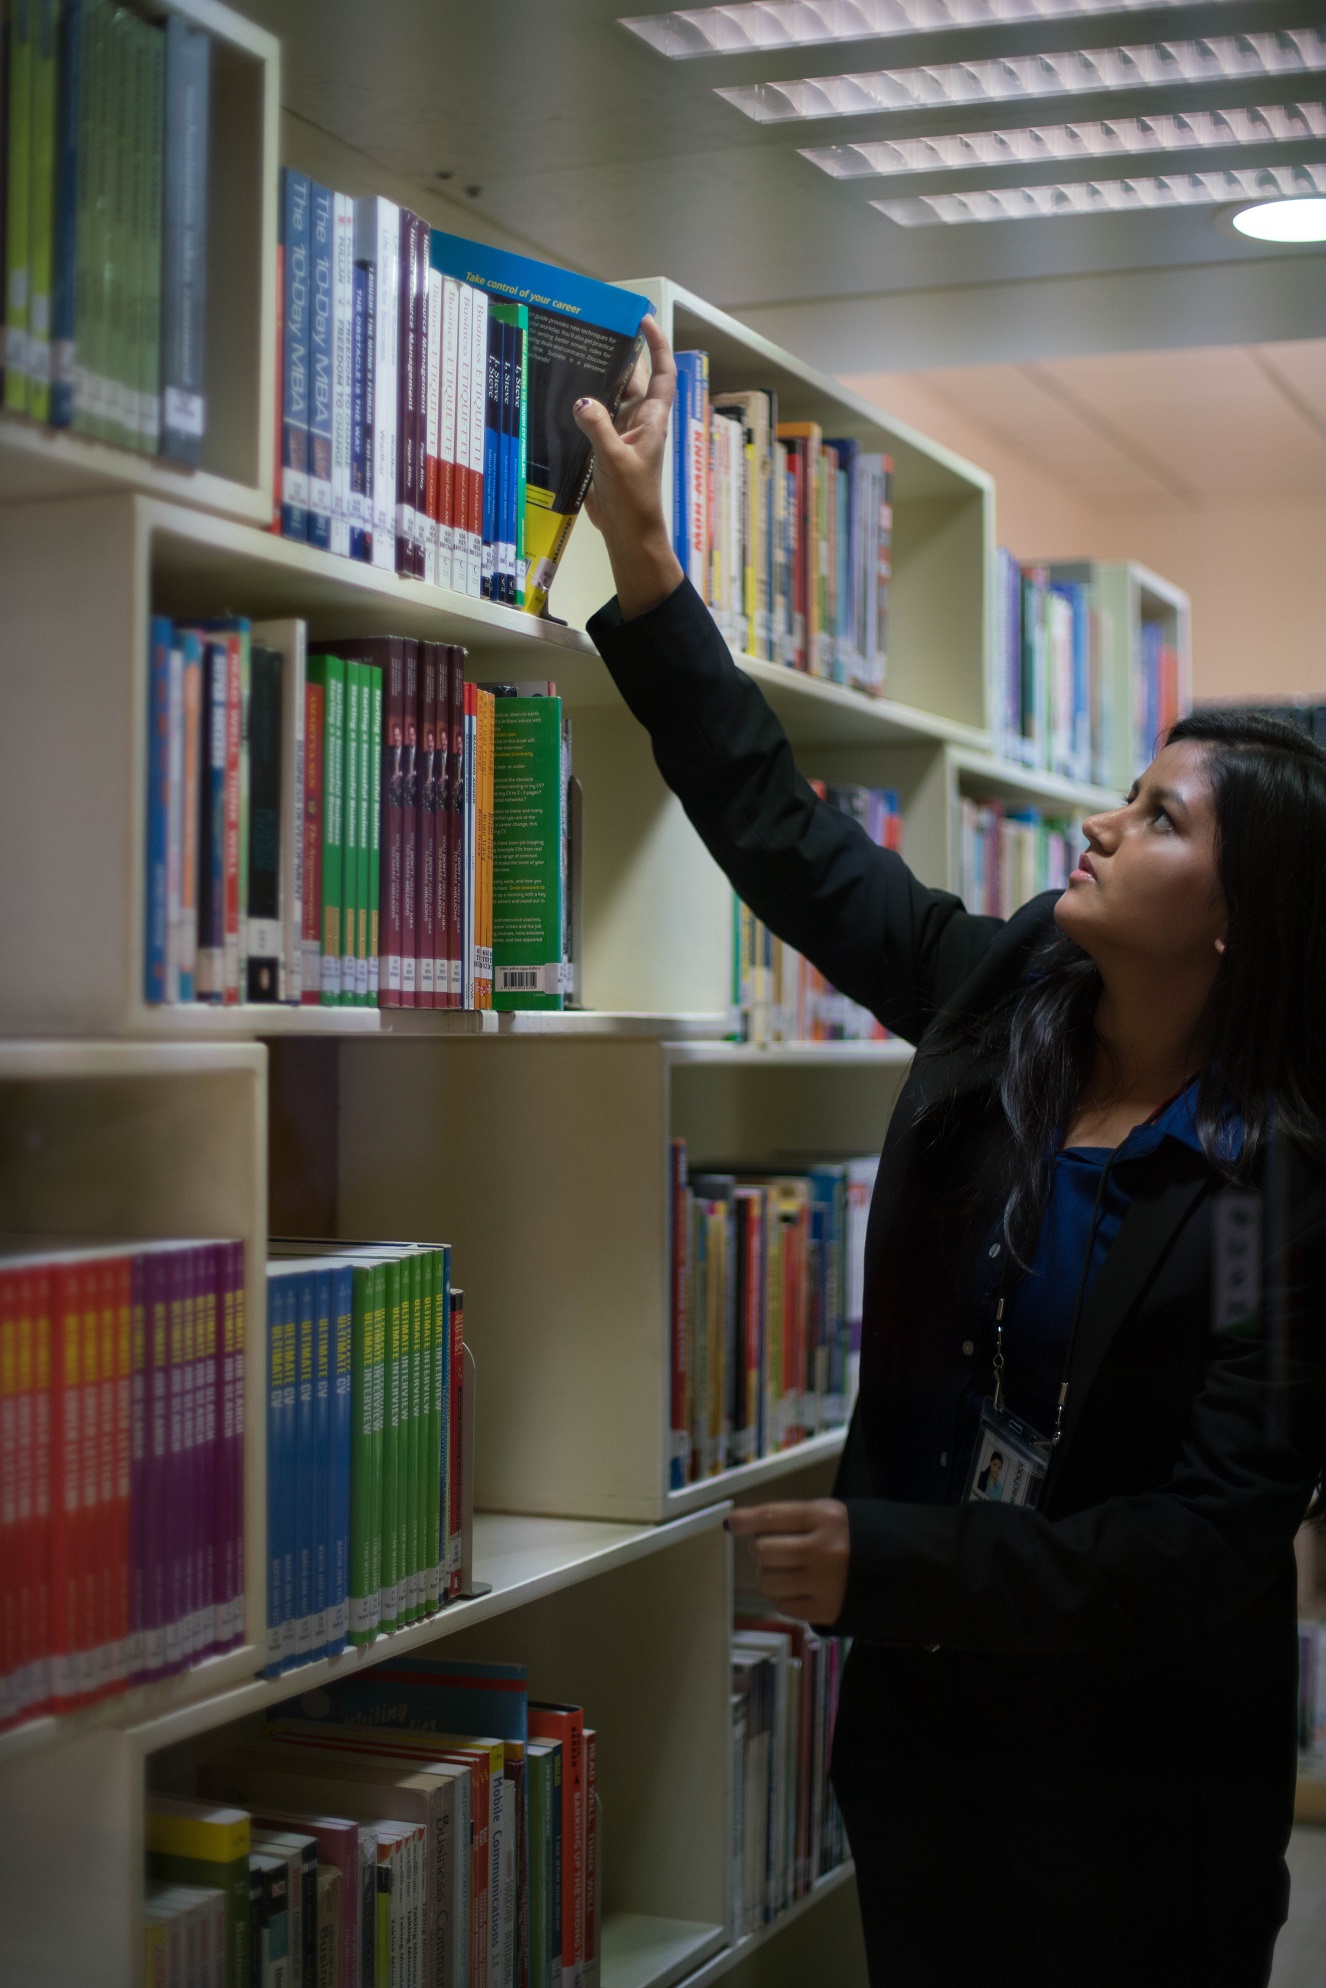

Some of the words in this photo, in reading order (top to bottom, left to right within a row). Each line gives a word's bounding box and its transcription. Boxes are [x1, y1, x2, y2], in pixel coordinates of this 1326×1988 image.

[293, 182, 307, 231] The
[316, 195, 330, 243] The
[288, 244, 307, 338] 10-Day
[312, 254, 330, 349] 10-Day
[431, 284, 439, 345] Business
[466, 272, 485, 285] Take
[487, 279, 518, 294] control
[519, 289, 530, 298] of
[529, 293, 551, 305] your
[552, 299, 582, 315] career
[447, 291, 456, 353] Business
[463, 296, 471, 357] Business
[476, 304, 485, 364] Business
[536, 313, 548, 321] guide
[549, 315, 569, 329] provides
[570, 324, 580, 332] new
[580, 328, 607, 341] techniques
[607, 336, 617, 344] for
[537, 330, 553, 341] writing
[554, 335, 569, 345] better
[589, 348, 602, 356] rules
[561, 328, 574, 338] You'll
[591, 338, 615, 351] practical
[291, 342, 306, 412] MBA
[336, 319, 344, 387] FREEDOM
[420, 336, 428, 415] Management
[547, 350, 567, 361] Success
[583, 362, 606, 373] personal
[587, 354, 609, 366] Discover
[314, 352, 330, 422] MBA
[336, 390, 343, 409] TO
[429, 351, 438, 452] ETIQUETTE
[445, 358, 455, 457] ETIQUETTE
[460, 363, 470, 462] ETIQUETTE
[335, 412, 343, 468] CHANGE
[474, 370, 484, 466] ETIQUETTE
[361, 686, 369, 731] Starting
[373, 689, 381, 734] Starting
[361, 742, 369, 799] Successful
[373, 744, 381, 801] Successful
[360, 800, 368, 848] Business
[318, 1317, 328, 1377] ULTIMATE
[336, 1315, 346, 1375] ULTIMATE
[363, 1312, 373, 1366] ULTIMATE
[392, 1306, 400, 1359] ULTIMATE
[435, 1293, 443, 1345] ULTIMATE
[454, 1313, 464, 1356] NUTS!
[301, 1320, 311, 1381] ULTIMATE
[300, 1383, 310, 1401] CV
[317, 1380, 328, 1398] CV
[336, 1377, 346, 1394] CV
[363, 1368, 372, 1435] INTERVIEW
[391, 1361, 399, 1427] INTERVIEW
[588, 1743, 596, 1781] READ
[492, 1776, 503, 1823] Mobile
[573, 1791, 581, 1850] BARKING
[436, 1815, 449, 1902] Business
[573, 1852, 580, 1868] UP
[491, 1831, 503, 1948] Communications
